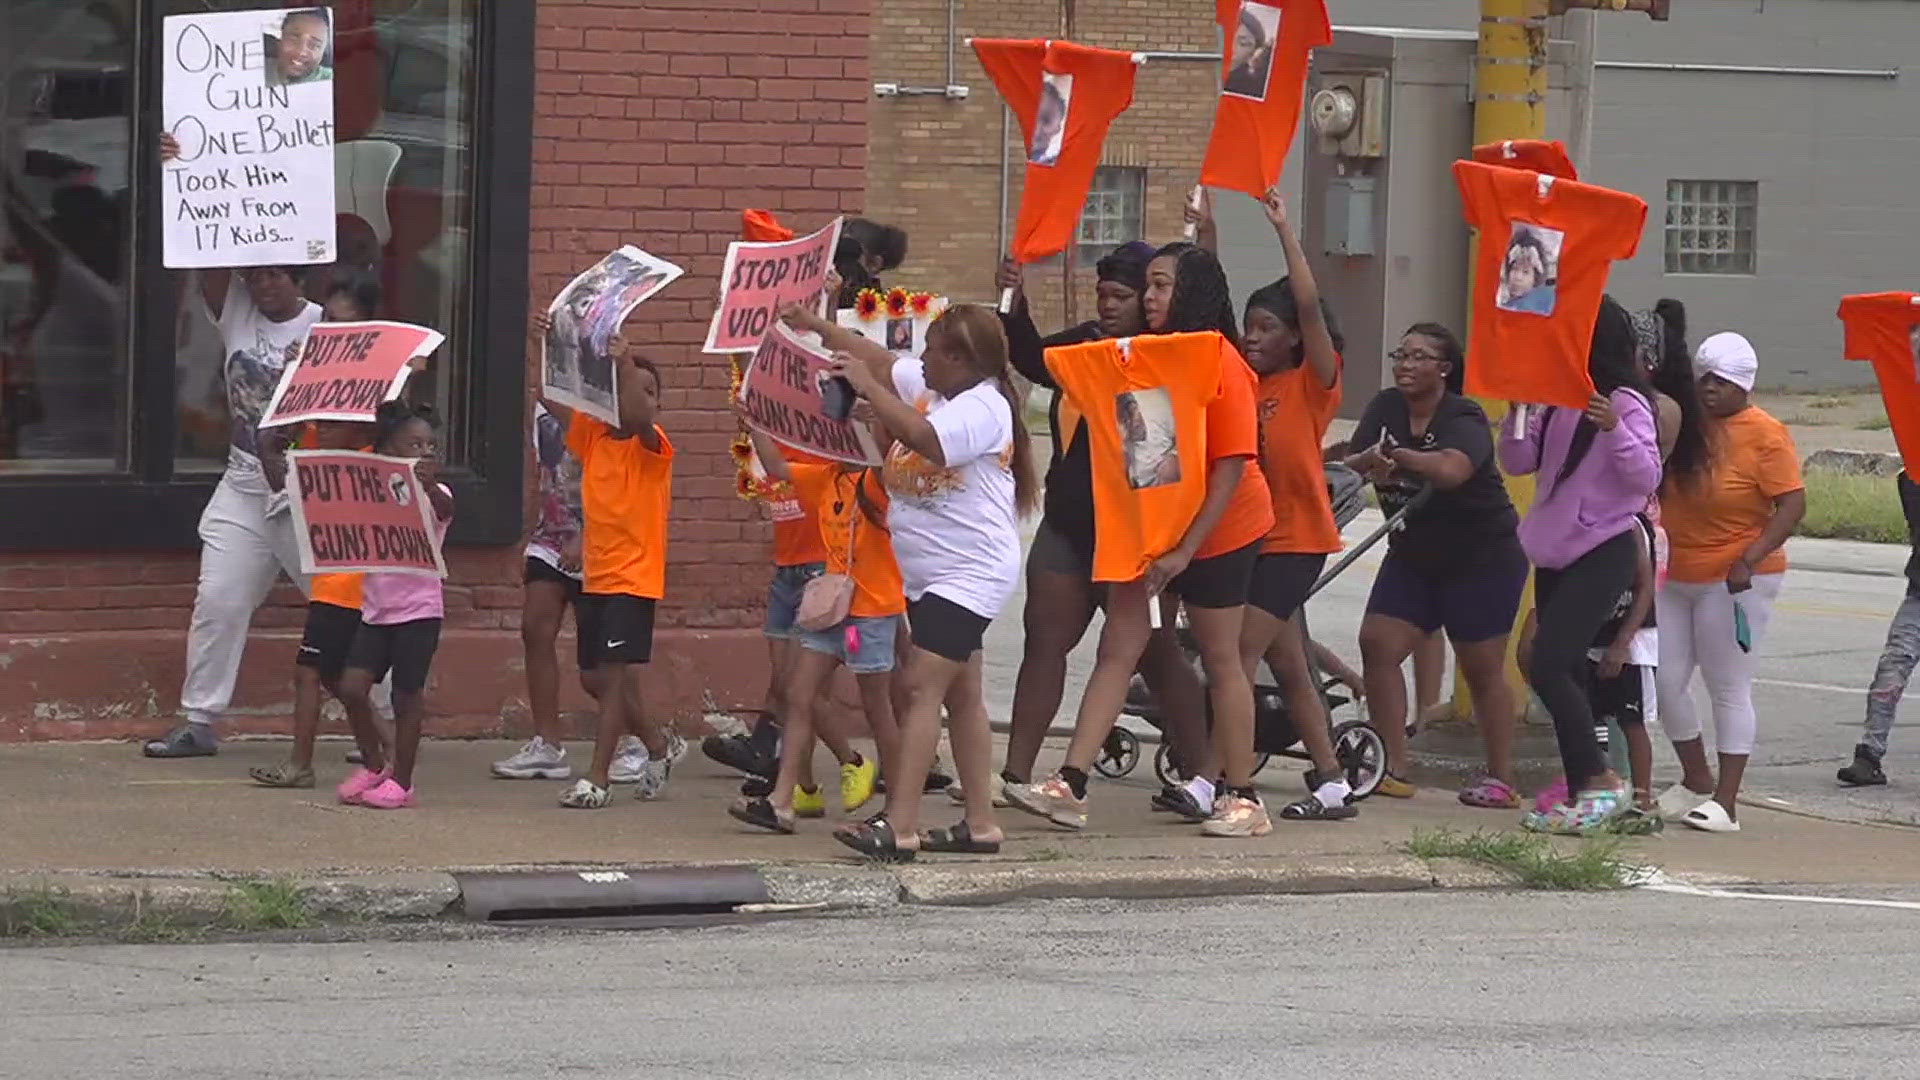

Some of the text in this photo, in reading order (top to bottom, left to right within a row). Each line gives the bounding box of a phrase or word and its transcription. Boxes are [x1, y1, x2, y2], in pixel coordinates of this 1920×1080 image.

[176, 23, 264, 73] ONE
[206, 72, 289, 111] GUN
[172, 115, 254, 162] ONE
[177, 197, 298, 221] AWAY FROM
[195, 223, 219, 251] 17
[731, 245, 824, 290] STOP THE
[299, 332, 381, 368] PUT THE
[781, 346, 810, 394] THE
[274, 378, 392, 415] GUNS DOWN
[794, 409, 867, 460] DOWN
[298, 464, 387, 503] PUT THE
[310, 524, 436, 564] GUNS DOWN
